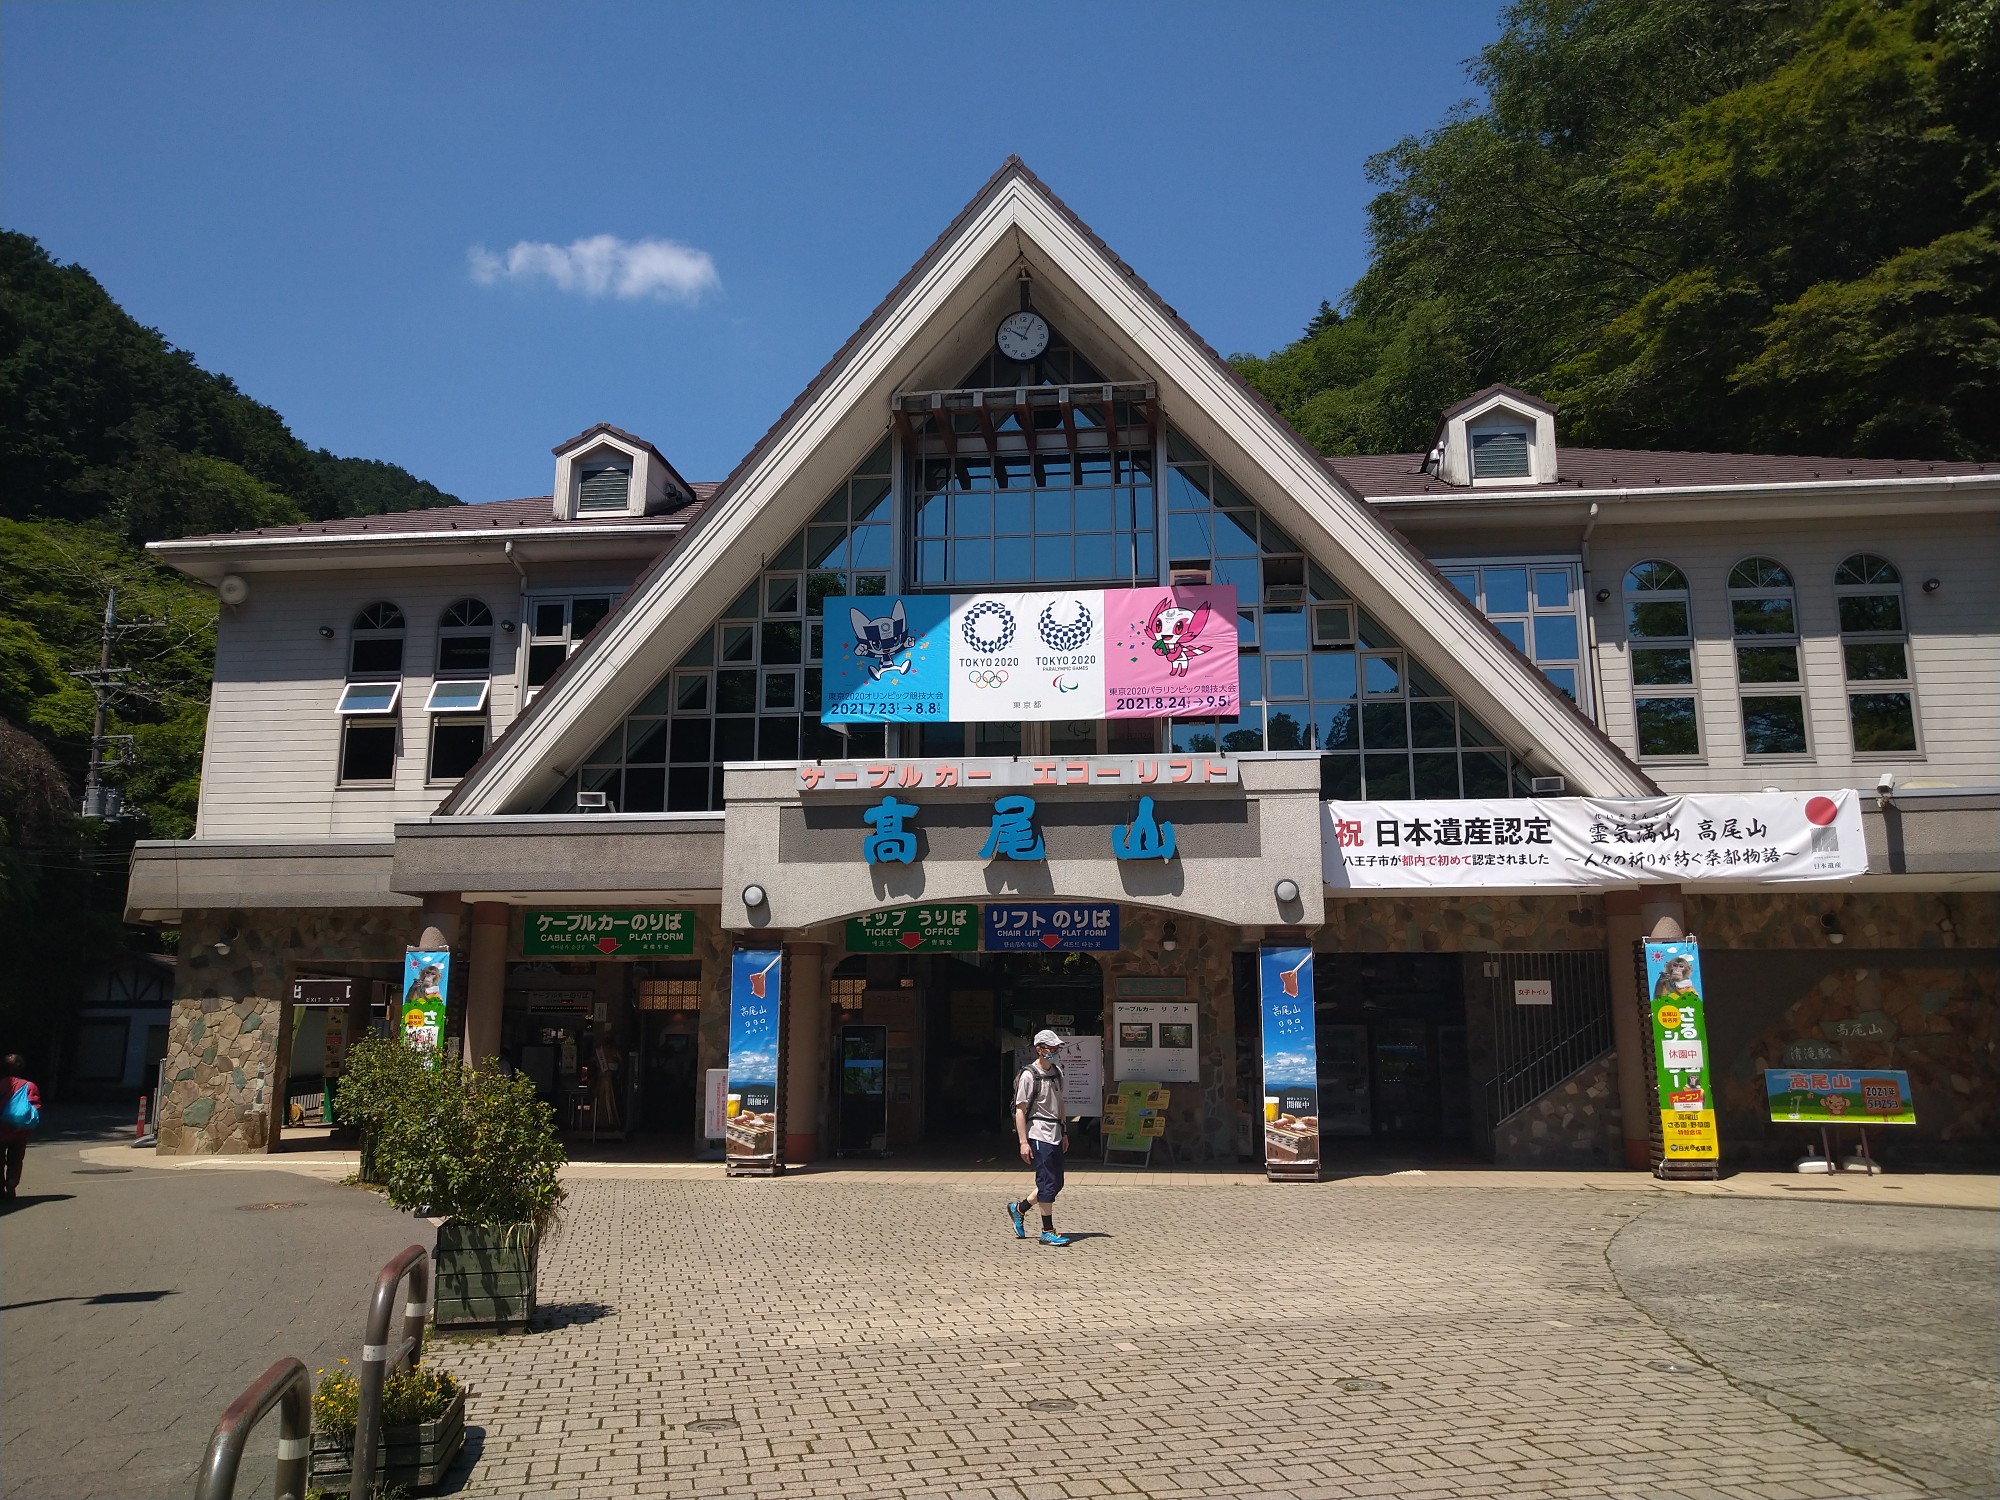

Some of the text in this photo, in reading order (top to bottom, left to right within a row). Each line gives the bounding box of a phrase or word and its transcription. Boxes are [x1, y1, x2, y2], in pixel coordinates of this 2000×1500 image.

[959, 658, 1018, 667] TOKYO 2020
[1036, 655, 1096, 665] TOKYO 2020
[828, 692, 944, 700] 東京2020オリンピック競技大会
[1109, 684, 1237, 696] 東京2020パラリンピック競技大会
[831, 703, 896, 715] 2021.7.23
[916, 703, 936, 714] 8.8
[1013, 701, 1042, 709] 東京都
[1116, 697, 1186, 710] 2021.8.24
[1206, 696, 1226, 708] 9.5
[801, 761, 1229, 789] ケーブルカー エコーリフト
[1335, 816, 1552, 848] 祝 日本遺産認定
[1589, 817, 1768, 844] 霊気満山 高尾山
[1342, 853, 1550, 867] 八王子市が都内で初めて認定されました
[537, 913, 682, 932] ケーブルカーのりば
[918, 910, 967, 926] うりば
[993, 910, 1111, 928] リフト のりば
[541, 934, 571, 942] CABLE
[629, 933, 652, 941] PLAT
[656, 933, 684, 941] FORM
[865, 928, 960, 936] TICKET OFFICE
[1669, 1050, 1697, 1059] 休園中
[1790, 1073, 1851, 1090] 高尾山
[1866, 1087, 1895, 1096] 2021年
[1672, 1094, 1699, 1102] オープン
